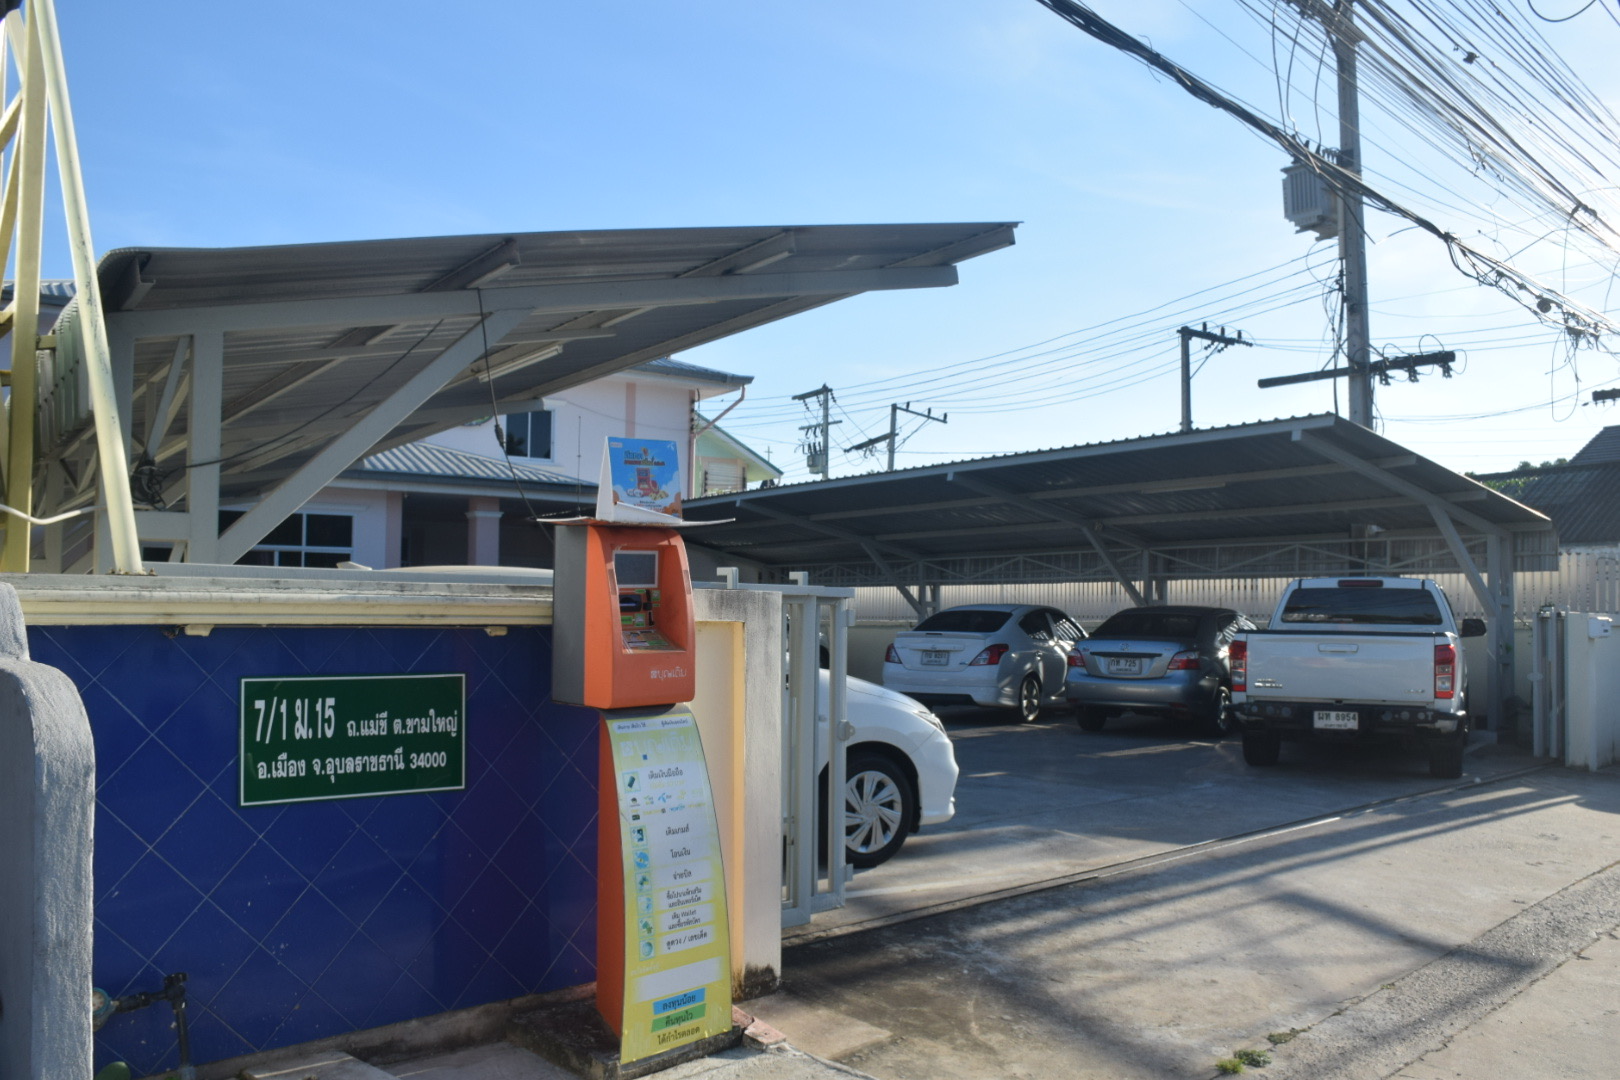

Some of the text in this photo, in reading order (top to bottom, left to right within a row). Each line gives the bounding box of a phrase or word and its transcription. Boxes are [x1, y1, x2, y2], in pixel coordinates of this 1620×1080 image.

[254, 696, 458, 744] 7/1 ม.15 ถ.แม่ชี ต.ขามใหญ่
[1335, 712, 1357, 721] 8954
[257, 746, 447, 784] อ.เมือง จ.อุบลราชธานี 34000
